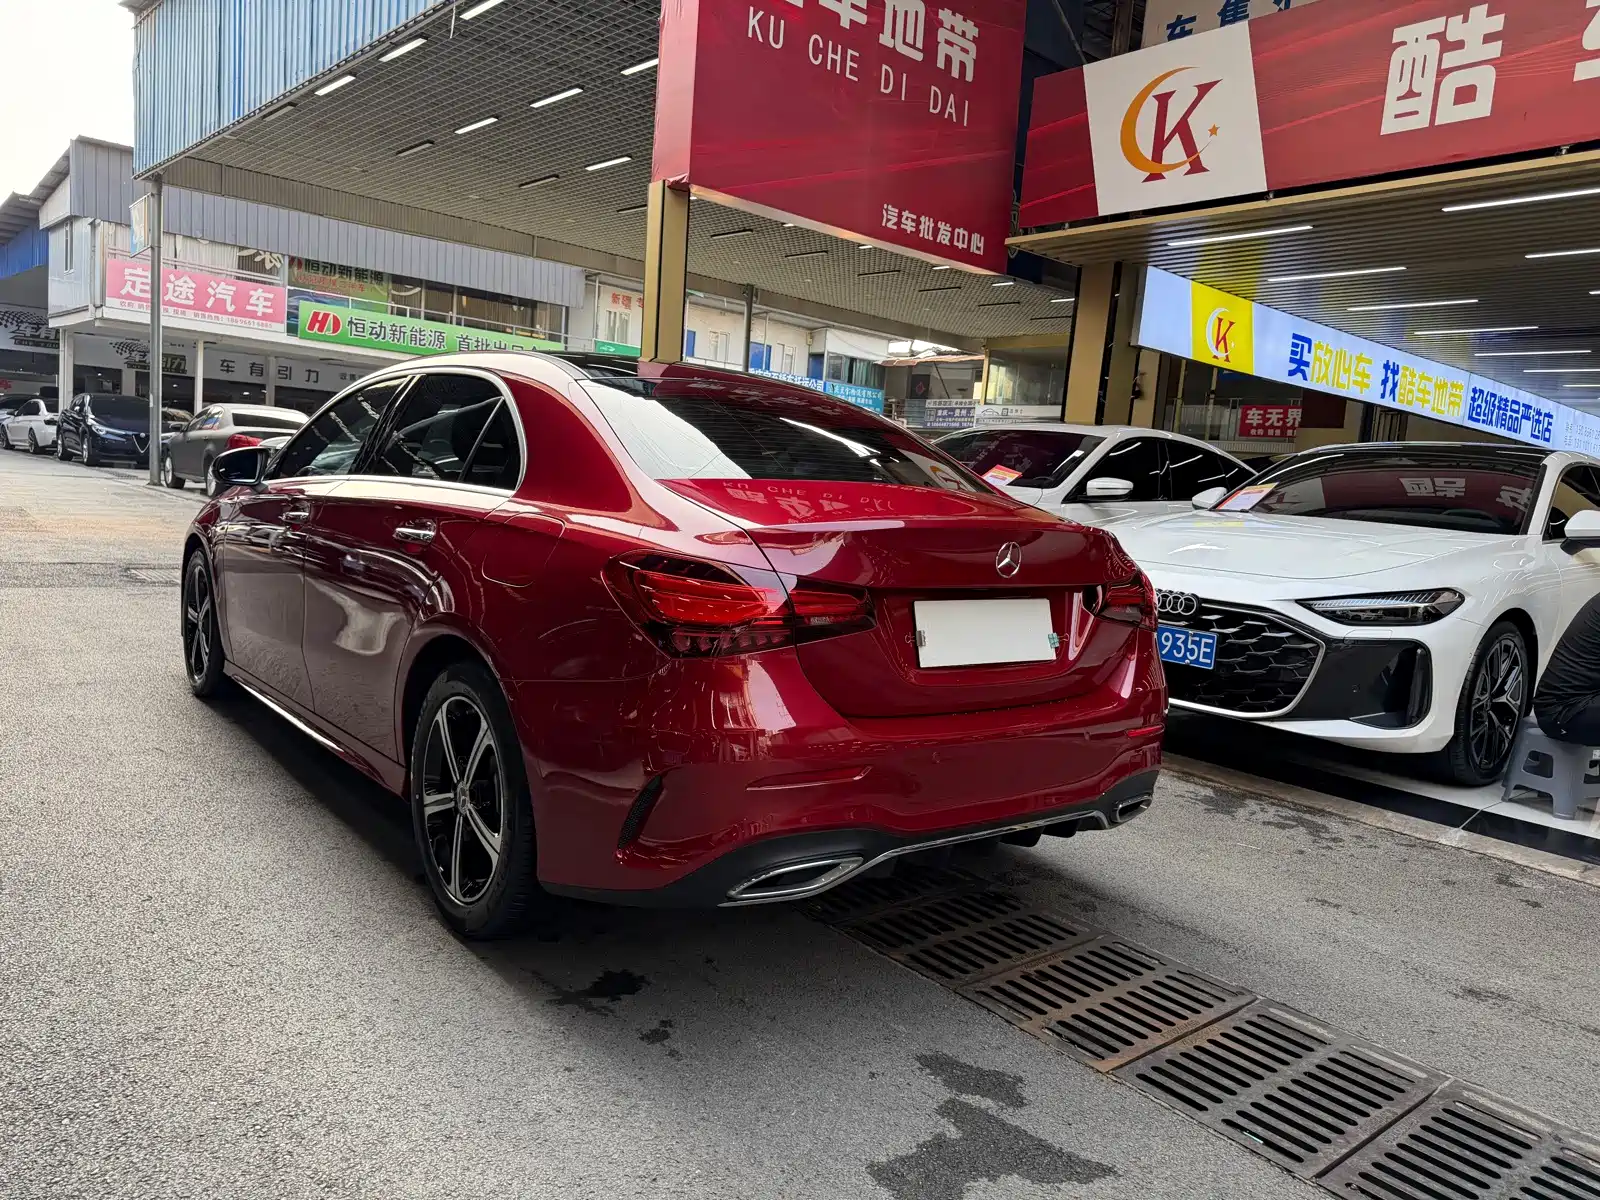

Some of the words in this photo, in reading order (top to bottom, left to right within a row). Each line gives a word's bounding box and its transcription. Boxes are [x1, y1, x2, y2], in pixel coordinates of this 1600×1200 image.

[747, 6, 785, 50] KU
[808, 34, 860, 82] CHE
[880, 64, 906, 101] DI
[929, 85, 969, 127] DAI
[881, 203, 985, 256] 汽车批发中心
[119, 267, 275, 317] 定途汽车
[347, 316, 446, 350] 恒动新能源
[219, 358, 320, 384] 车有引力
[1287, 333, 1374, 396] 买放心车
[1380, 359, 1463, 417] 找酷车地带
[1245, 408, 1302, 427] 车无界
[1467, 385, 1554, 443] 超级精品严选店
[1161, 631, 1213, 664] 935E
